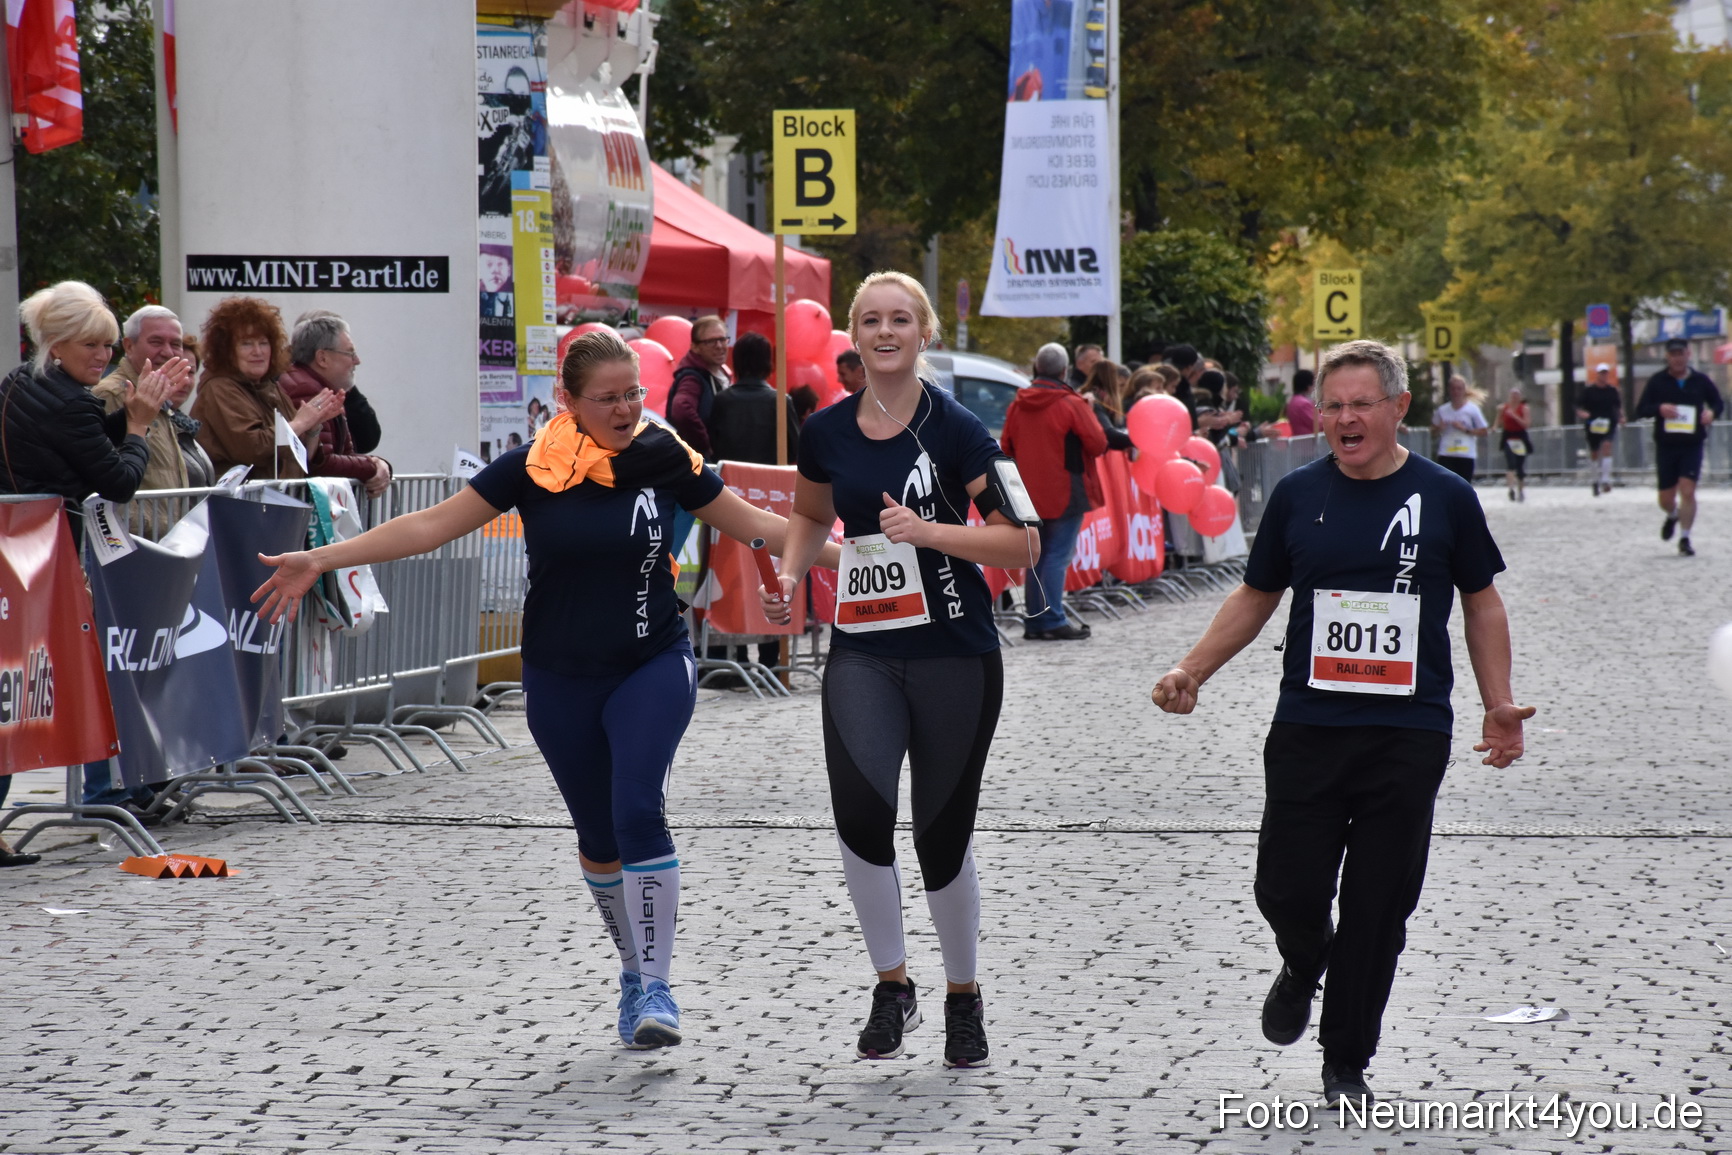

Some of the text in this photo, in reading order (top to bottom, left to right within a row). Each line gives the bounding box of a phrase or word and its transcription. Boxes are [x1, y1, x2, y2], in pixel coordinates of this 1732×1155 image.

[492, 109, 509, 123] CUP
[783, 115, 846, 137] Block
[795, 148, 836, 207] B
[516, 209, 540, 233] 18.
[188, 260, 439, 288] www.MINI-Partl.de
[1319, 273, 1354, 285] Block
[1325, 290, 1348, 323] C
[1435, 326, 1452, 349] D
[636, 525, 662, 638] RAIL.ONE
[848, 562, 906, 596] 8009
[855, 602, 899, 616] RAIL.ONE
[1327, 621, 1402, 655] 8013
[1336, 662, 1387, 676] RAIL.ONE
